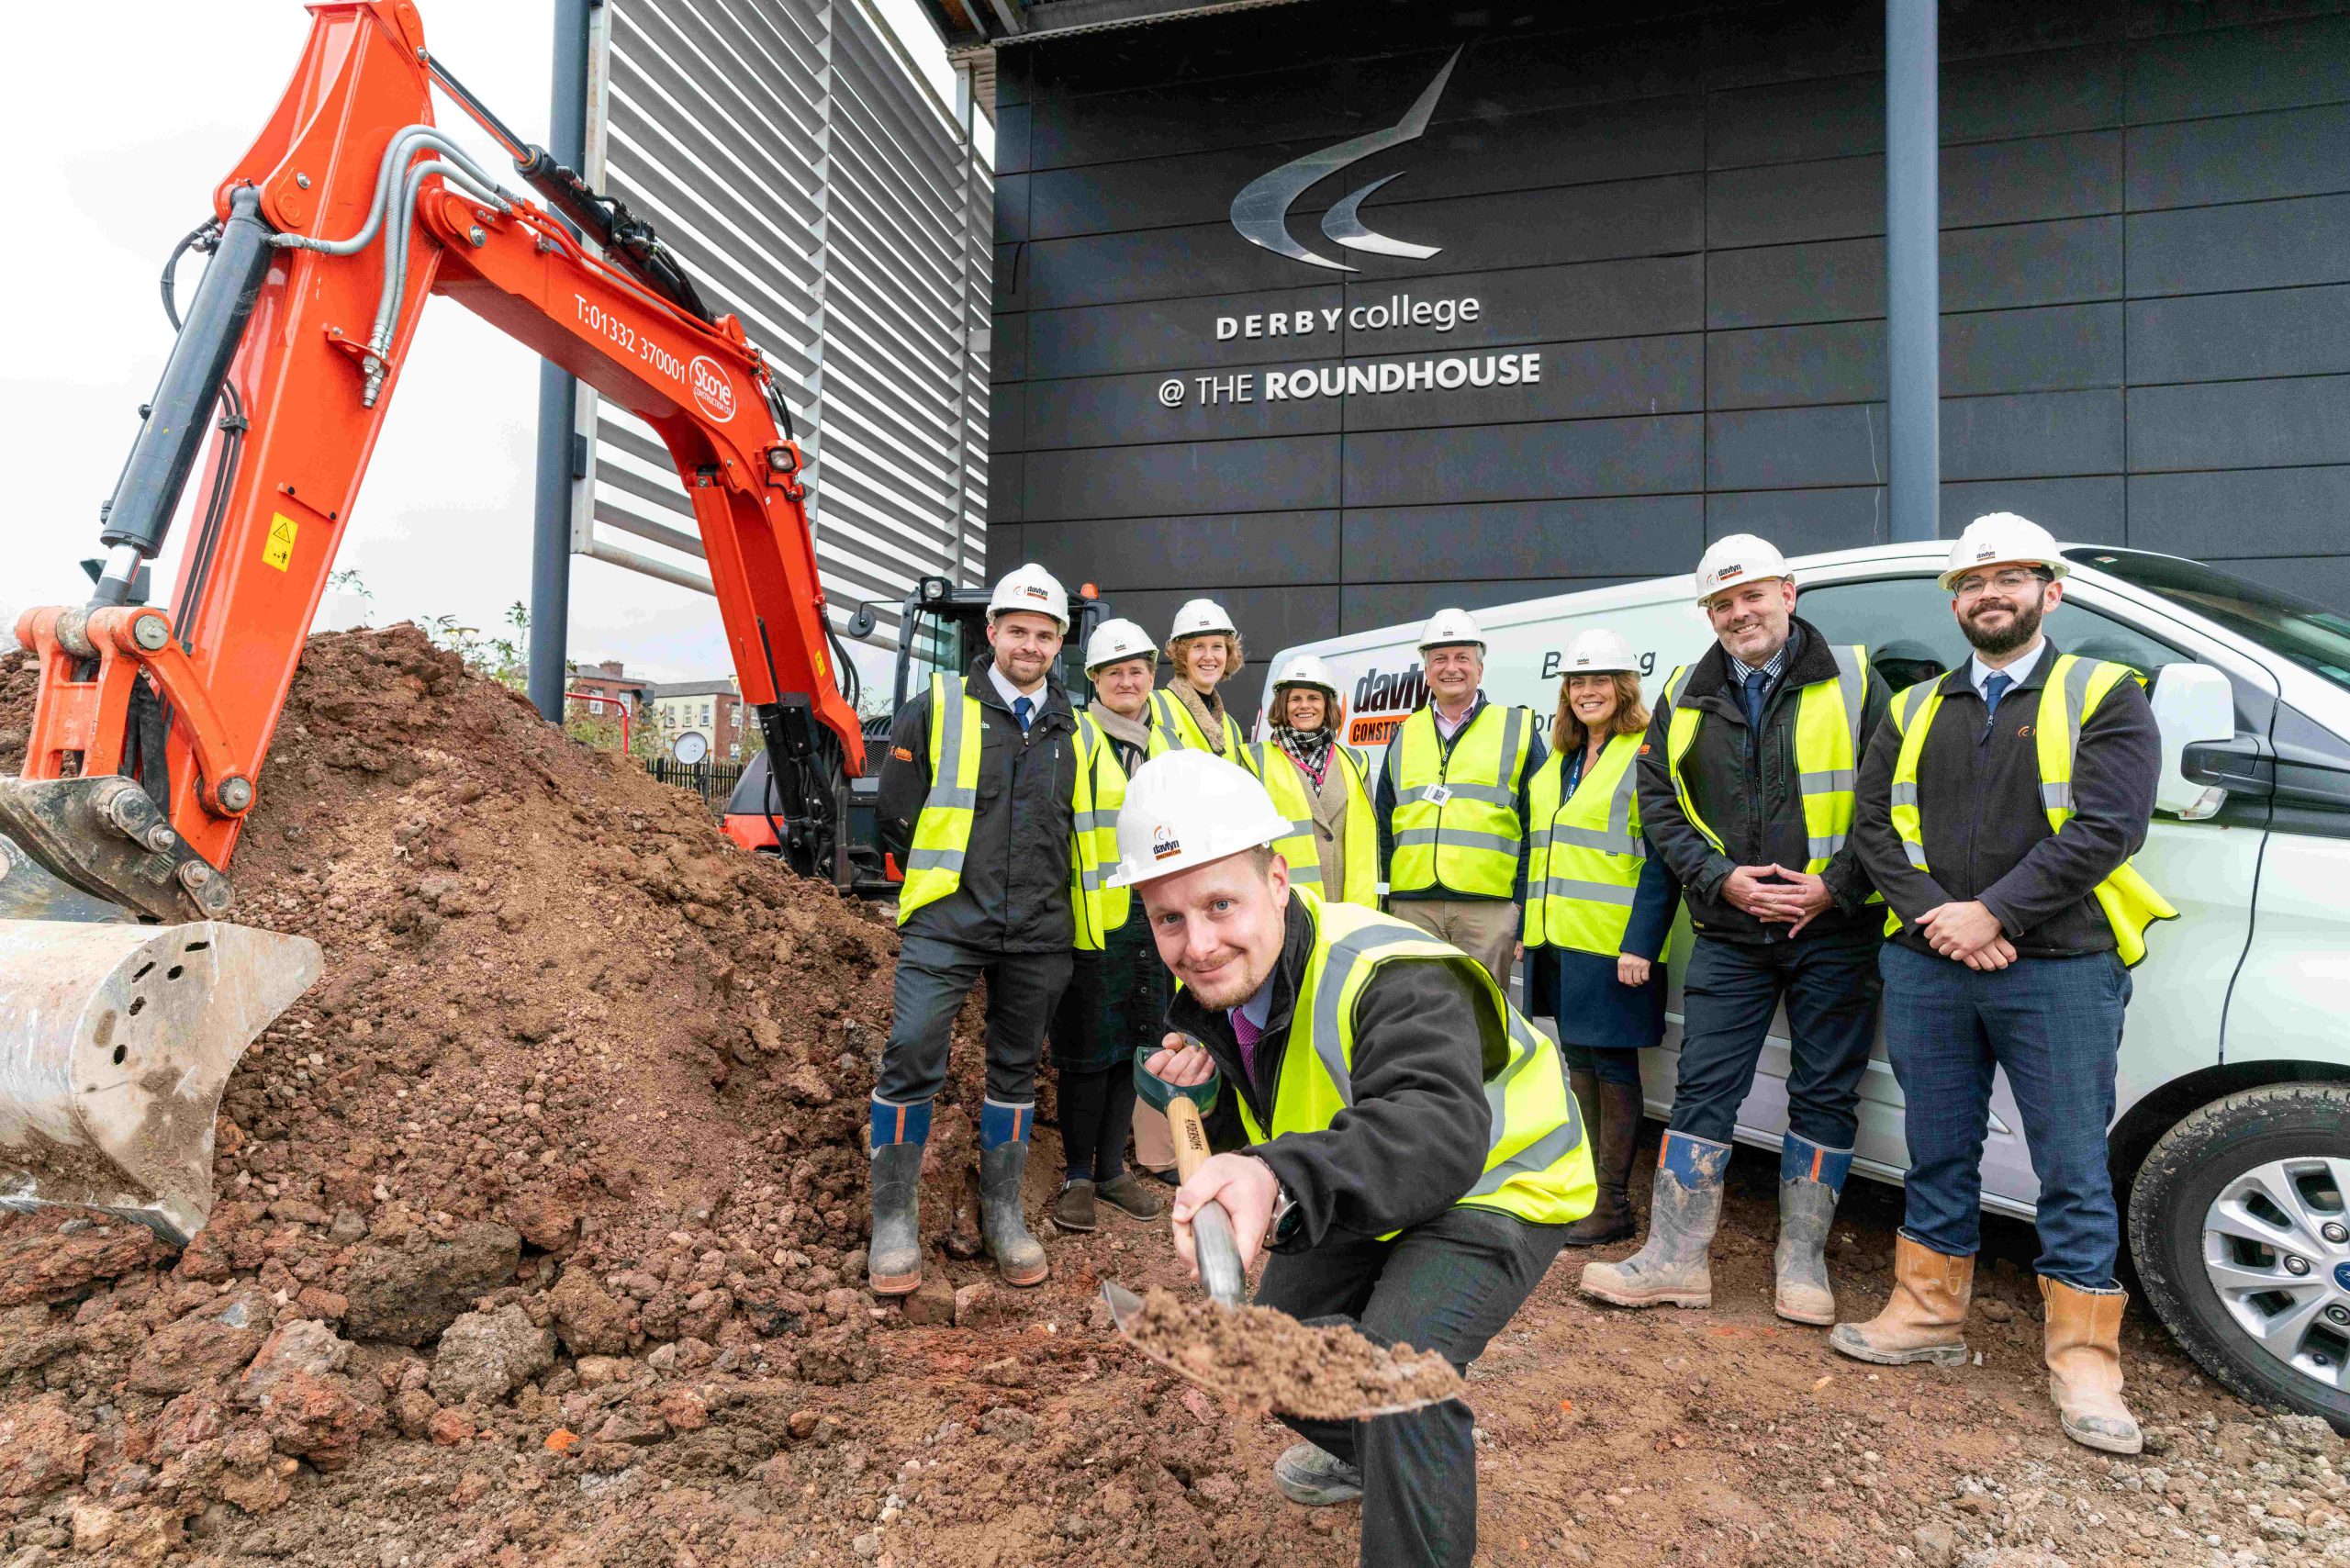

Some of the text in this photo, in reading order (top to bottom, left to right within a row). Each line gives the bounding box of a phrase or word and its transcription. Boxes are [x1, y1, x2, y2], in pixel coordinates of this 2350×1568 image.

[574, 293, 686, 384] T:01332 370001
[1216, 294, 1480, 341] DERBY college
[693, 386, 724, 411] CONSTRUCTION
[695, 361, 732, 406] Stone
[1158, 353, 1540, 408] @ THE ROUNDHOUSE
